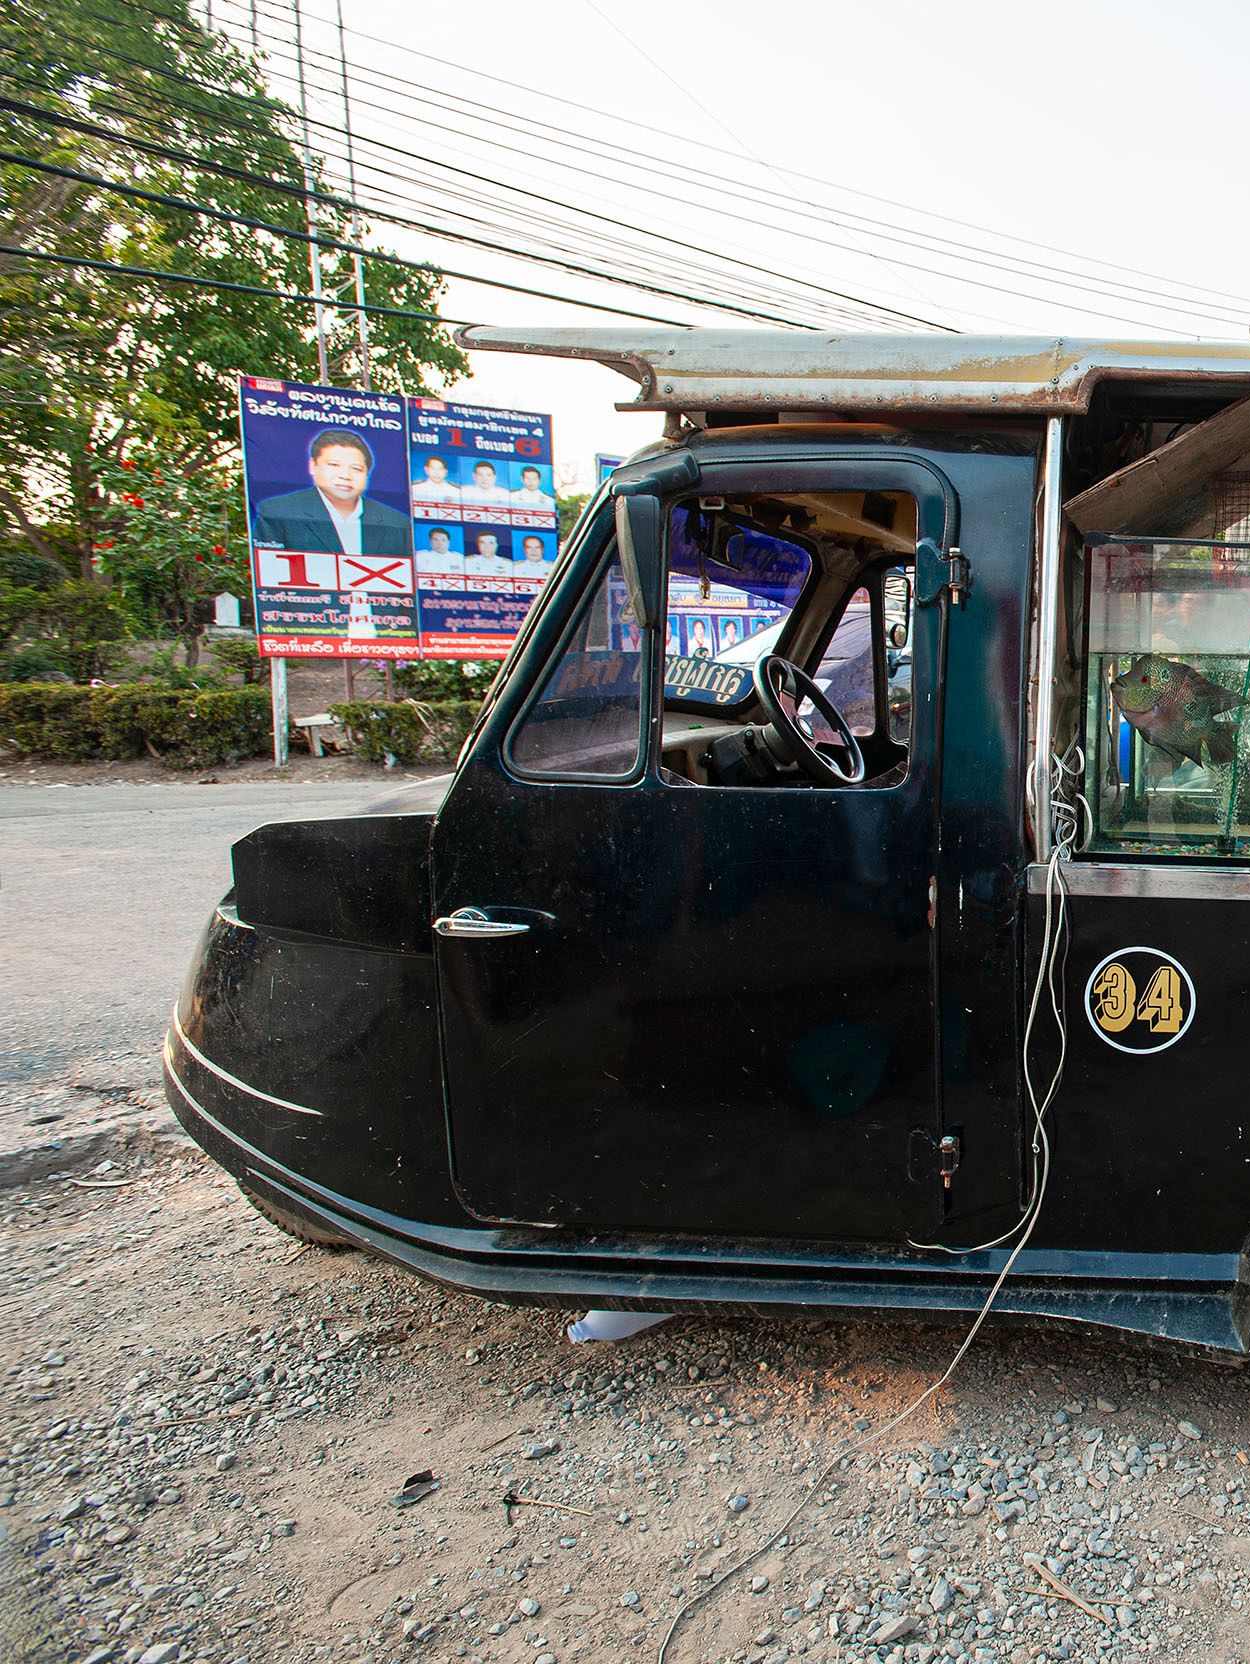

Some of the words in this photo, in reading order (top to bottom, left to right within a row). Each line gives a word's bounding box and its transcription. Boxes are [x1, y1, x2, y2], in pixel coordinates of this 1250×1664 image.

[532, 427, 545, 438] 4
[447, 427, 468, 449] 1
[515, 437, 542, 457] 6
[467, 512, 482, 521] 2
[515, 515, 530, 524] 3
[275, 554, 320, 587] 1
[473, 581, 488, 590] 5
[516, 583, 532, 593] 6
[1093, 962, 1184, 1033] 34
